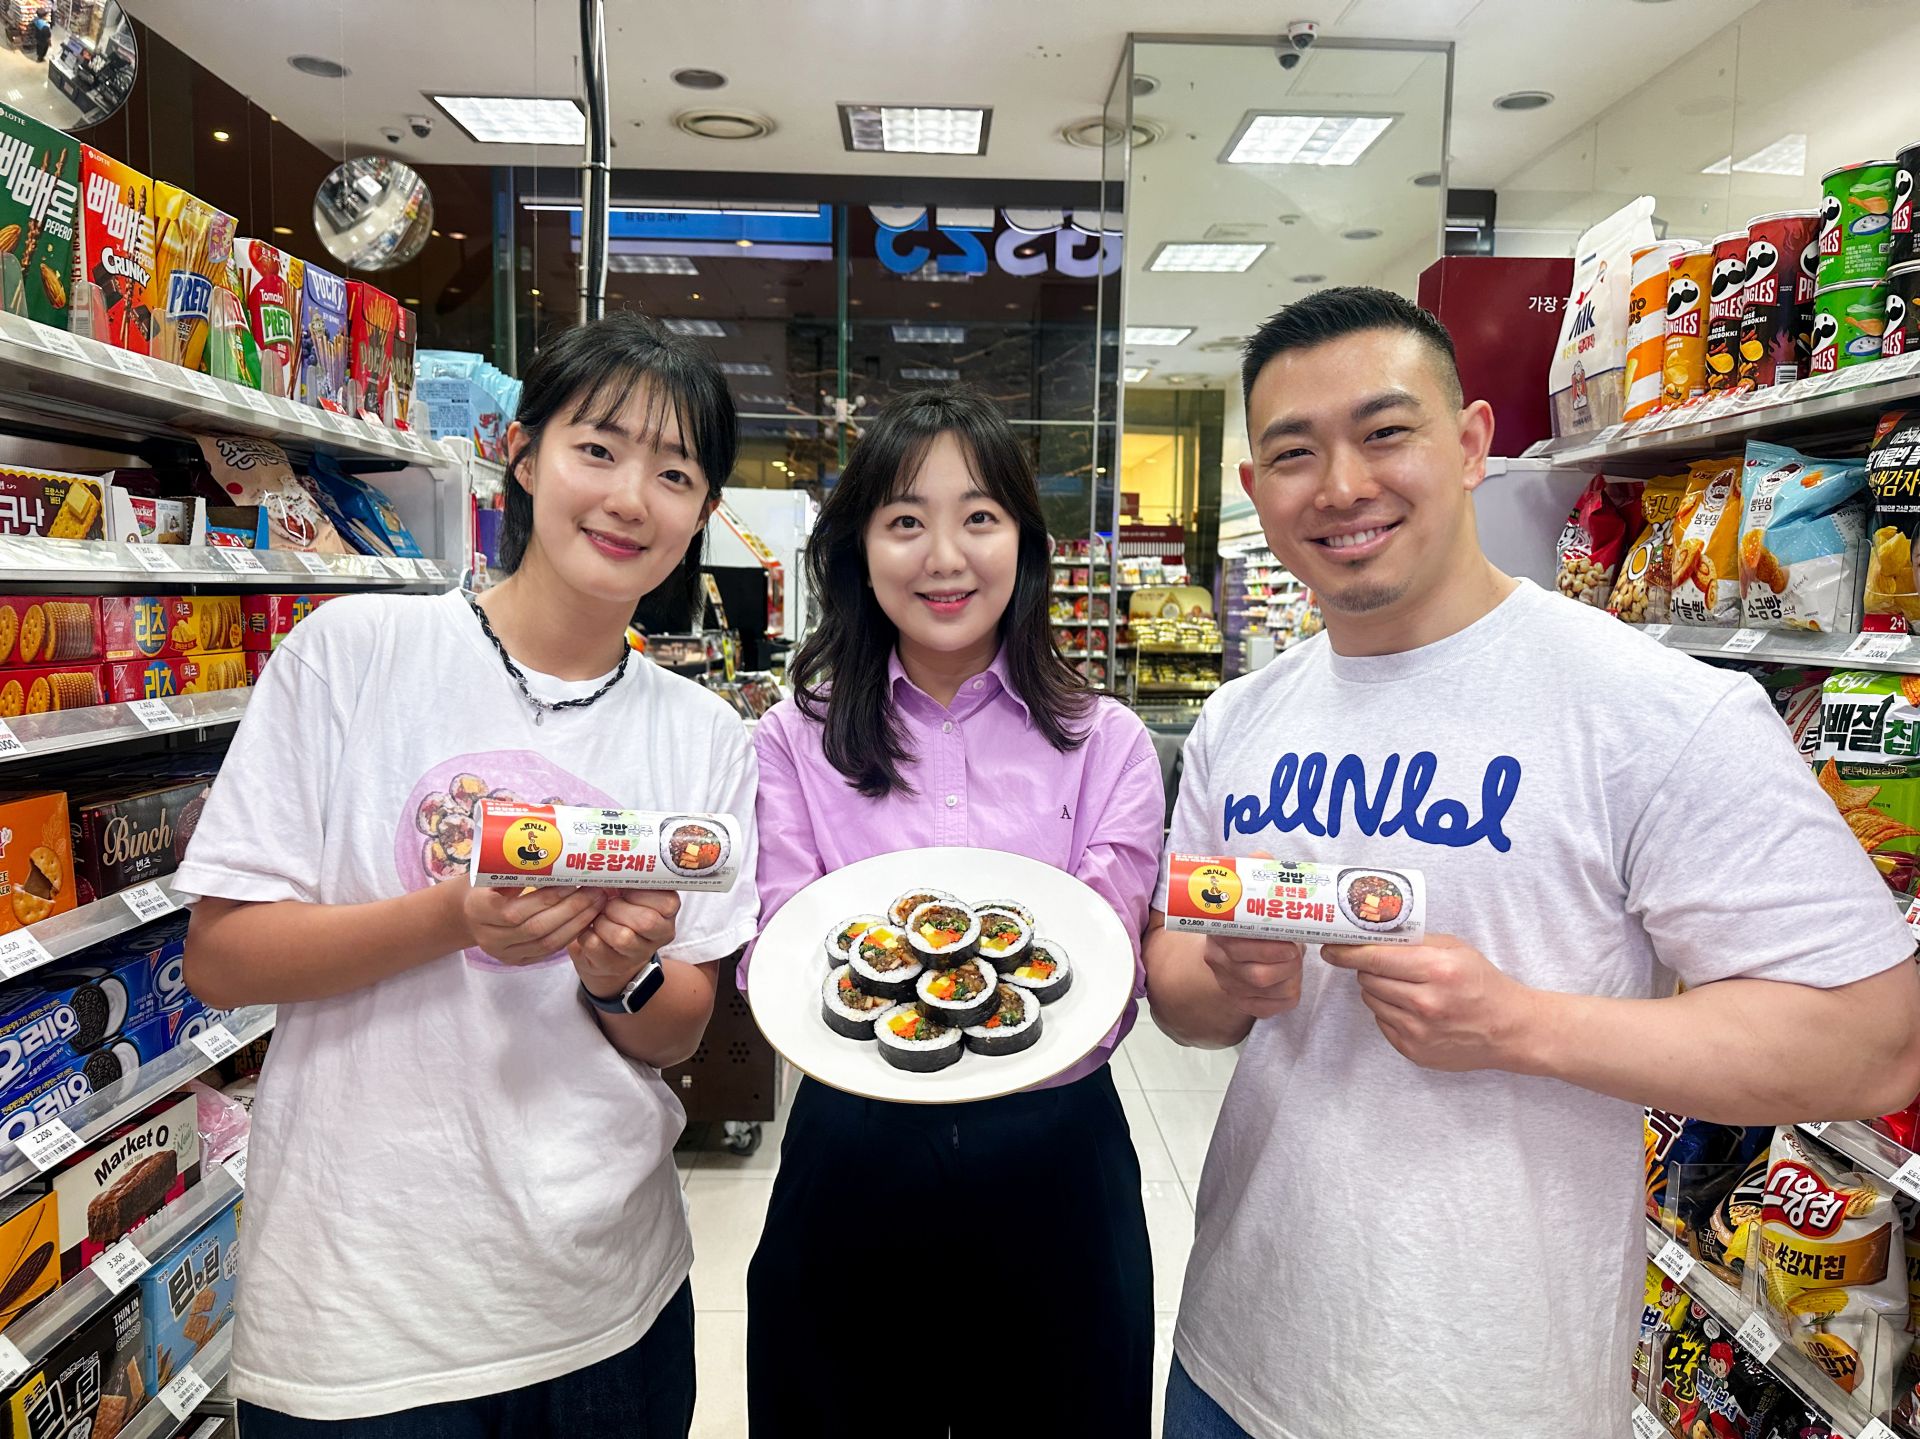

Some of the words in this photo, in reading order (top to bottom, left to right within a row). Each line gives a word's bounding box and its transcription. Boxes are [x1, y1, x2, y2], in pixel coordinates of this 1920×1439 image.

[4, 111, 26, 126] LOTTE
[86, 172, 155, 255] 빼빼로
[43, 218, 73, 241] PEPERO
[101, 246, 151, 289] CRUNKY
[169, 275, 212, 314] PRETZ
[259, 288, 284, 304] Tomato
[1528, 296, 1558, 312] 가장
[262, 308, 293, 339] PRETZ
[176, 602, 193, 615] 치즈
[1748, 595, 1782, 620] 소금빵
[134, 602, 168, 647] 리츠
[252, 613, 266, 633] RITZ
[1890, 617, 1907, 631] 2+1
[184, 663, 198, 677] 치즈
[102, 807, 173, 866] Binch
[596, 839, 631, 851] 롤앤롤
[566, 853, 645, 871] 매운잡채
[130, 888, 149, 900] 3,300
[1274, 885, 1309, 899] 롤앤롤
[1246, 898, 1324, 922] 매운잡채
[1187, 919, 1205, 927] 2,800
[0, 1006, 79, 1091] 오레오
[32, 1128, 53, 1145] 2,200
[94, 1128, 153, 1187] Market
[155, 1124, 169, 1148] O
[1763, 1167, 1844, 1228] 스윙칩
[106, 1252, 126, 1270] 3,300
[1669, 1246, 1685, 1261] 1,700
[1775, 1242, 1847, 1281] 생감자칩
[113, 1304, 131, 1326] THIN
[131, 1297, 140, 1312] IN
[115, 1317, 133, 1338] THIN
[1750, 1323, 1767, 1340] 1,700
[170, 1376, 187, 1394] 2,200
